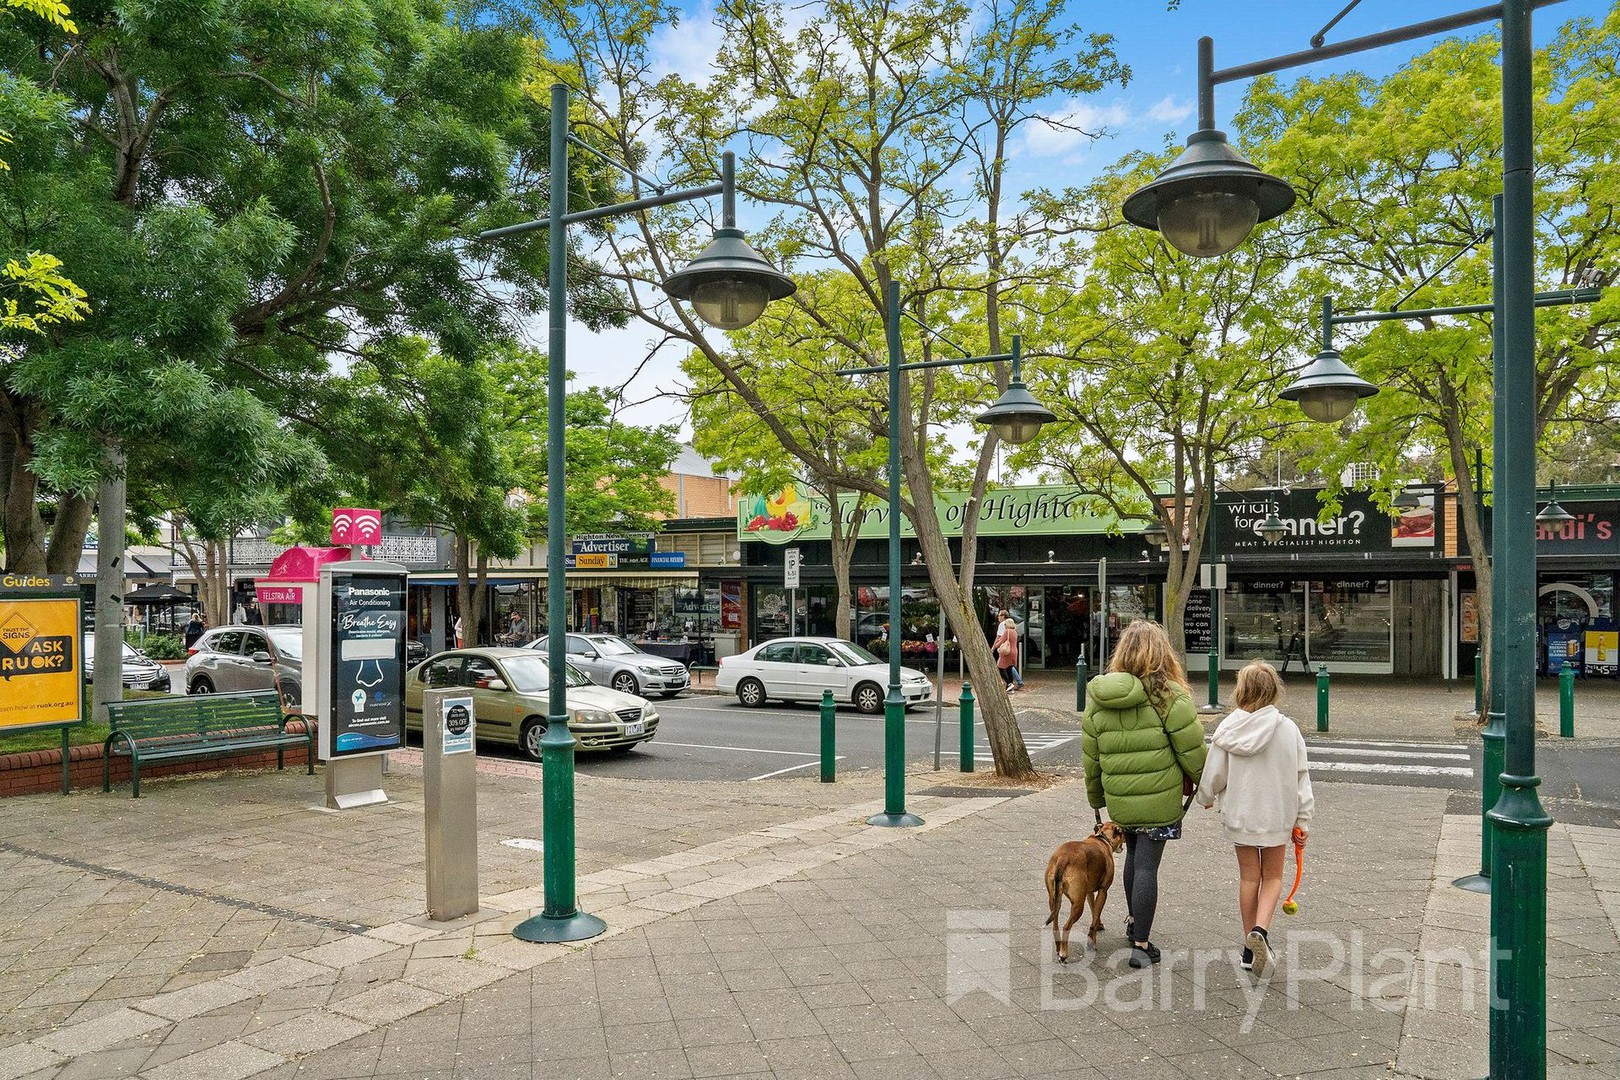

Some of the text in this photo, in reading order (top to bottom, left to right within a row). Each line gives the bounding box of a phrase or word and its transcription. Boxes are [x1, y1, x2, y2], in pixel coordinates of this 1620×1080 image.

[1234, 510, 1365, 537] for dnner?
[576, 533, 604, 541] Highton
[580, 540, 630, 553] Advertiser
[565, 556, 576, 565] Sun
[578, 556, 605, 567] Sunday
[2, 575, 51, 587] Guides
[1252, 581, 1285, 590] dinner?
[1336, 579, 1371, 589] dinner?
[348, 587, 391, 596] Panasonic
[262, 592, 285, 601] TELSTRA
[358, 599, 391, 607] Conditioning
[341, 614, 397, 630] Breathe Easy
[2, 631, 31, 640] SIGNS
[30, 640, 64, 654] ASK
[36, 700, 74, 709] ruok.org.au
